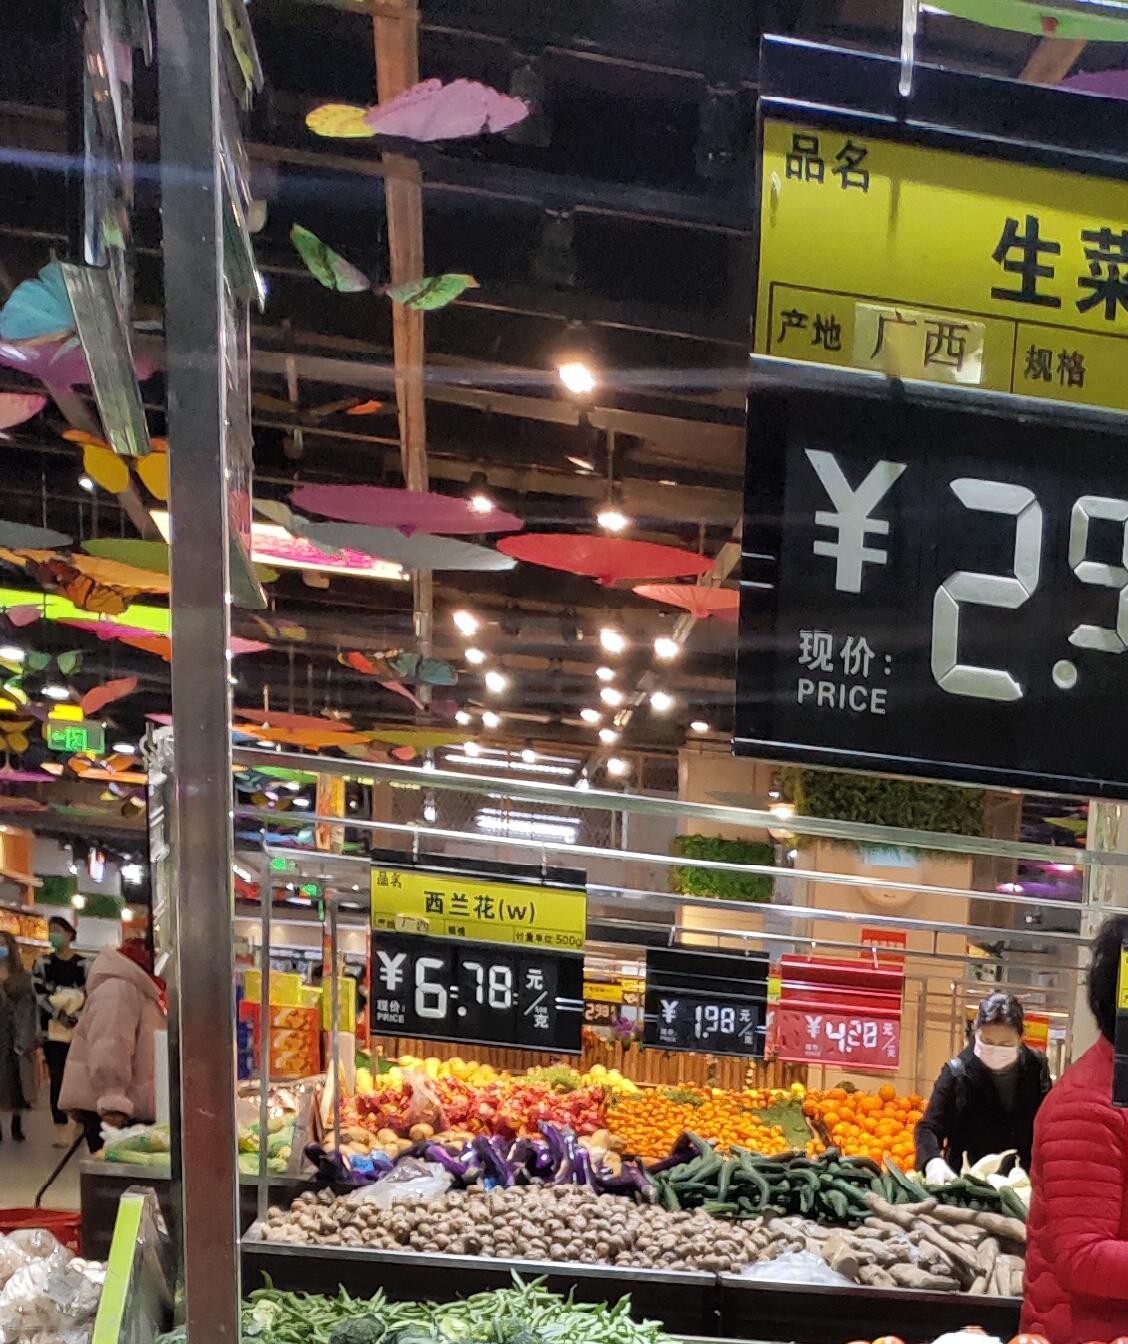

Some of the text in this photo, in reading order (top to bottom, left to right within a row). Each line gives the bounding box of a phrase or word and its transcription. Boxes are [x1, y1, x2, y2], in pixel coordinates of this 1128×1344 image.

[785, 133, 871, 194] 品名
[777, 308, 970, 372] 产地 广西
[1024, 345, 1086, 389] 规格
[798, 630, 893, 678] 现价:
[797, 678, 888, 715] PRICE
[424, 890, 536, 924] 西兰花(w)
